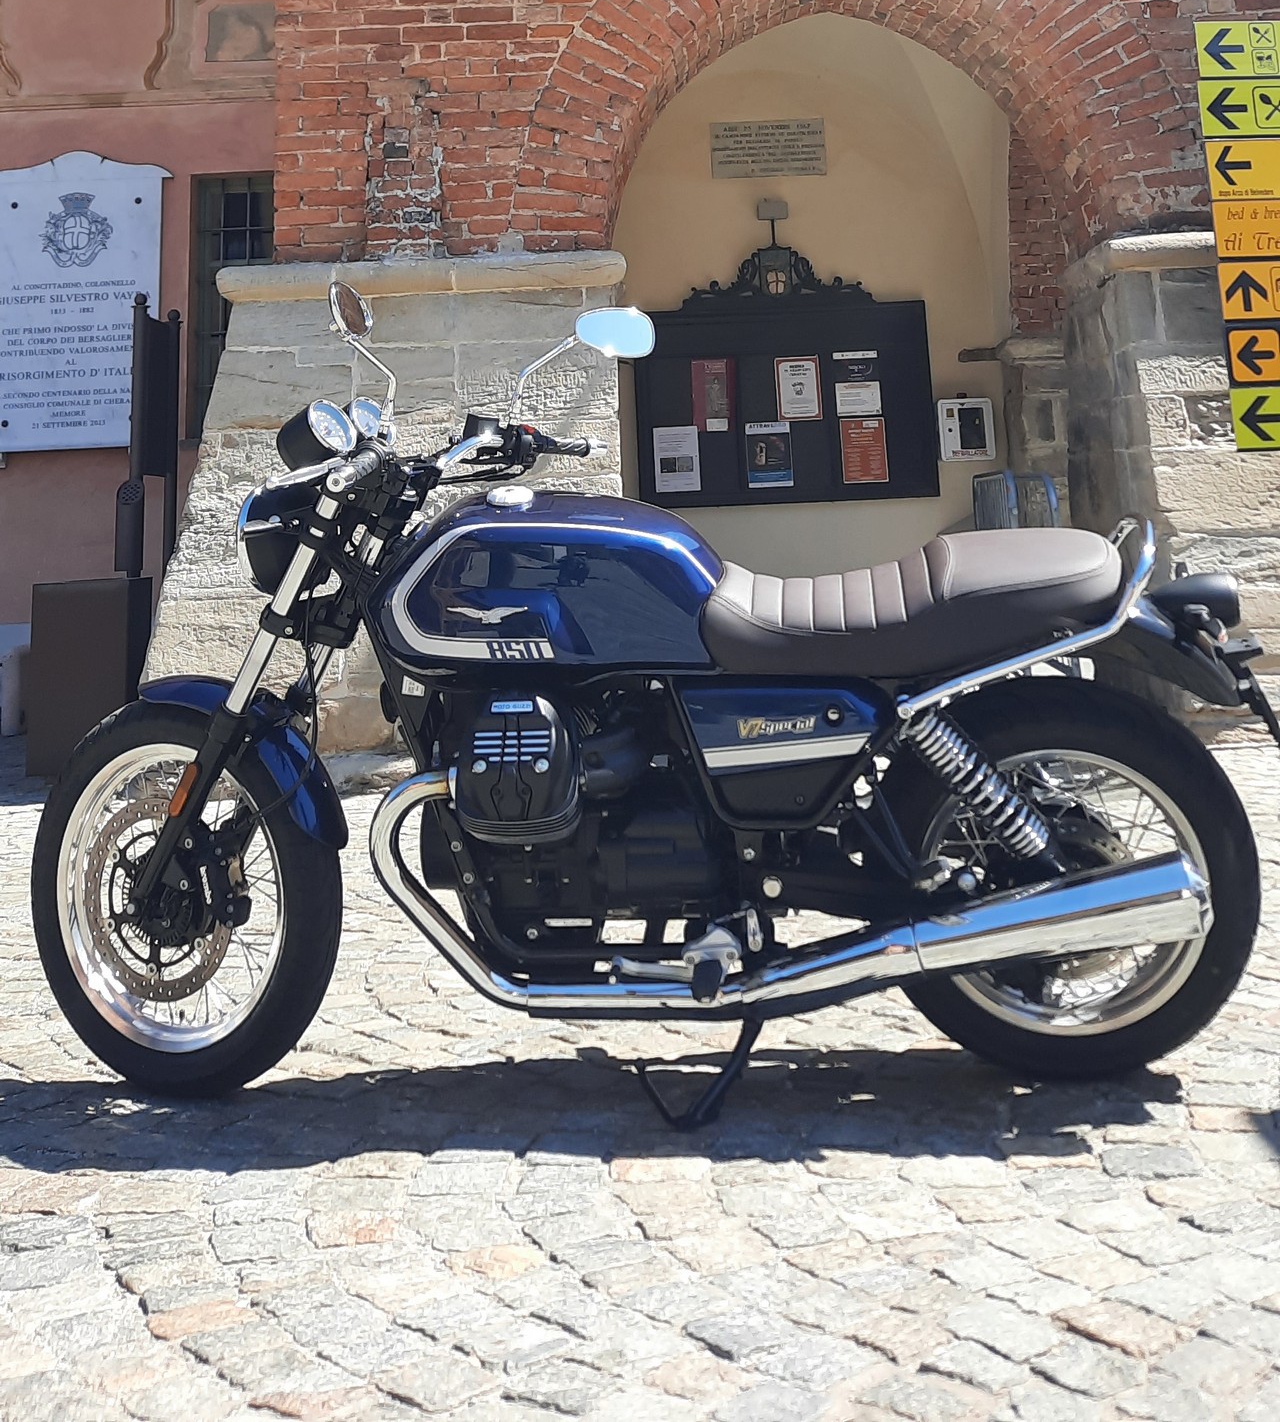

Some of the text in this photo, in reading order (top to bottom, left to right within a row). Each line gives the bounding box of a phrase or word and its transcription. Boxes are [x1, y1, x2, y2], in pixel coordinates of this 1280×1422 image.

[1227, 206, 1245, 220] bed
[1250, 208, 1259, 219] &
[1223, 232, 1243, 251] Ai
[24, 281, 83, 291] CONCITTADINO,
[85, 279, 136, 288] COLONNELLO
[0, 294, 46, 306] IUSEPPE
[49, 292, 109, 304] SILVESTRO
[2, 328, 20, 336] CHE
[22, 326, 51, 335] PRIMO
[53, 324, 94, 334] INDOSSO'
[96, 323, 108, 332] LA
[7, 333, 132, 347] DEL CORPO DEI BERSAGLIER
[65, 358, 77, 366] AL
[0, 368, 86, 381] RISORGIMENTO
[90, 368, 100, 377] D'
[3, 391, 40, 399] SECONDO
[42, 389, 91, 398] CENTENARIO
[93, 387, 118, 396] DELLA
[3, 401, 45, 410] CONSIGLIO
[47, 399, 91, 409] COMUNALE
[93, 398, 102, 406] DI
[51, 410, 86, 418] MEMORE
[42, 420, 88, 429] SETTEMBRE
[486, 640, 545, 660] 850
